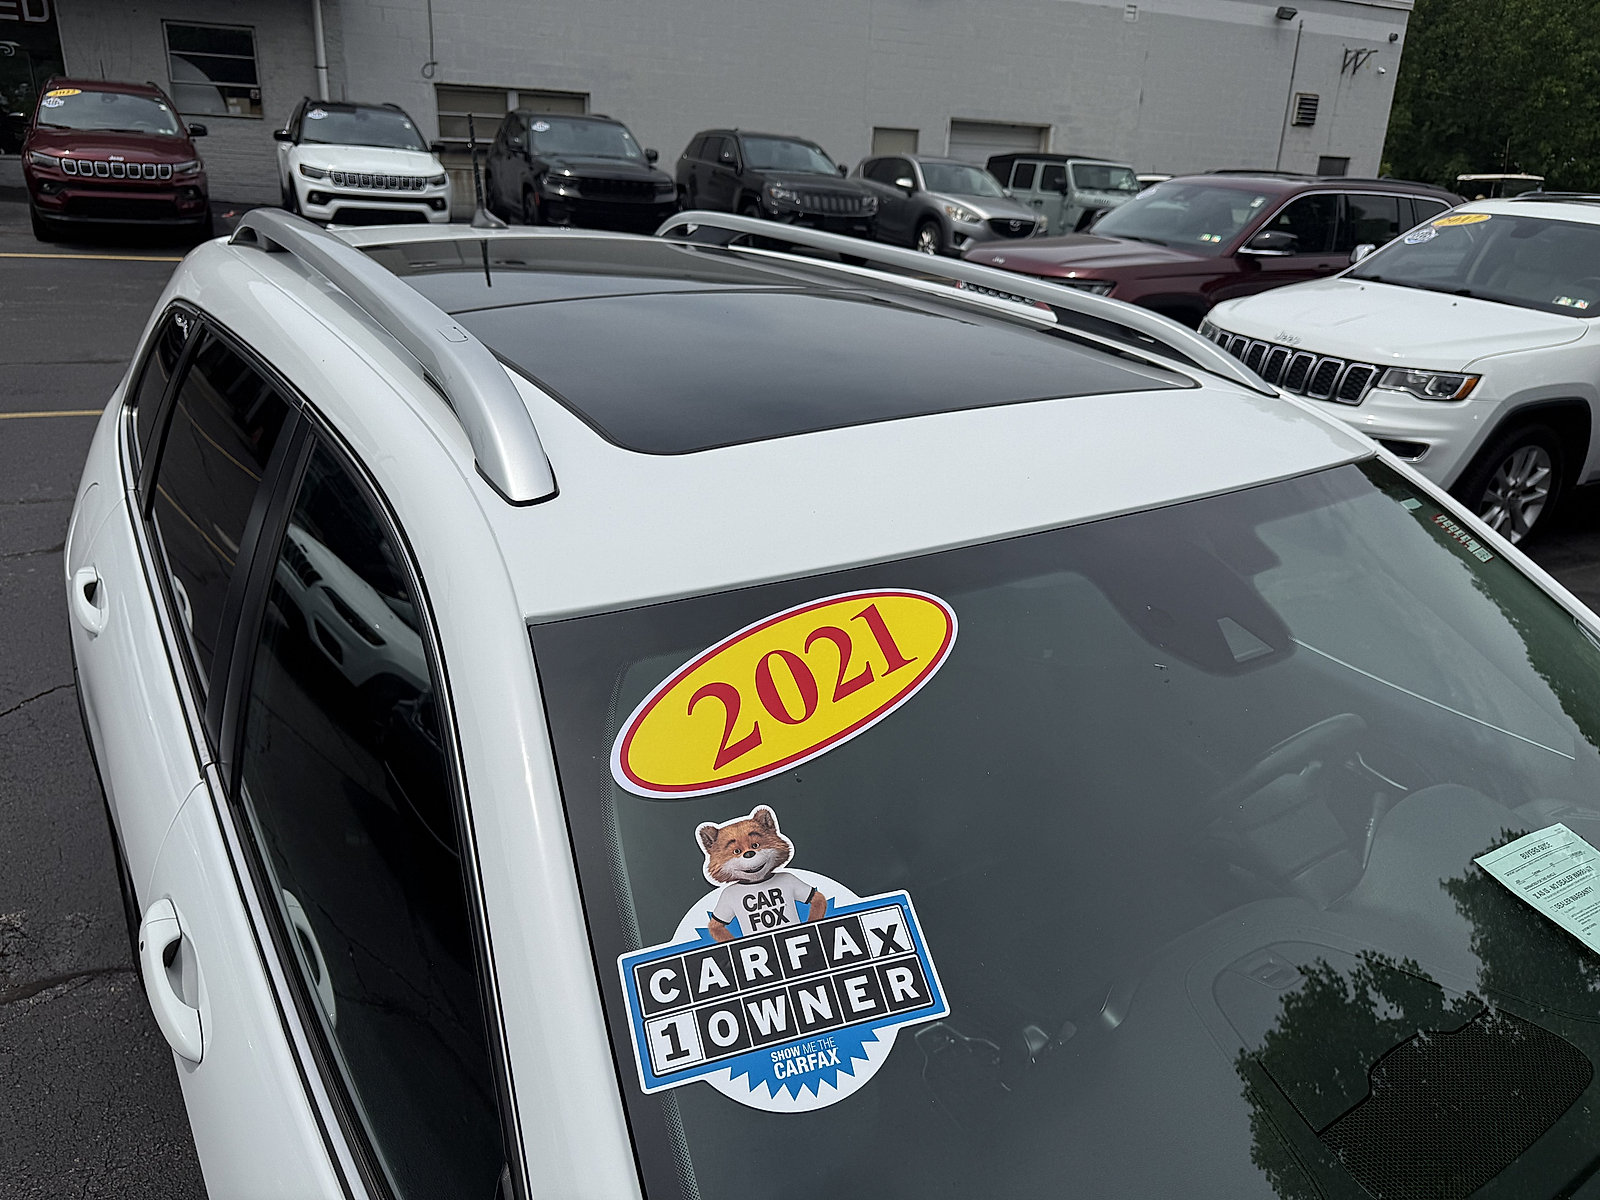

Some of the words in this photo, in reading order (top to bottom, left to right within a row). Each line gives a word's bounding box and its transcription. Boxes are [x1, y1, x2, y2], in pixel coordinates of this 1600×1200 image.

[686, 602, 918, 772] 2021
[742, 887, 785, 913] CAR
[749, 906, 790, 932] FOX
[648, 923, 907, 1004] CARFAX
[661, 1022, 690, 1061] 1
[707, 966, 920, 1048] OWNER
[771, 1045, 801, 1064] SHOW
[801, 1040, 818, 1056] ME
[816, 1036, 837, 1051] THE
[773, 1048, 842, 1081] CARFAX
